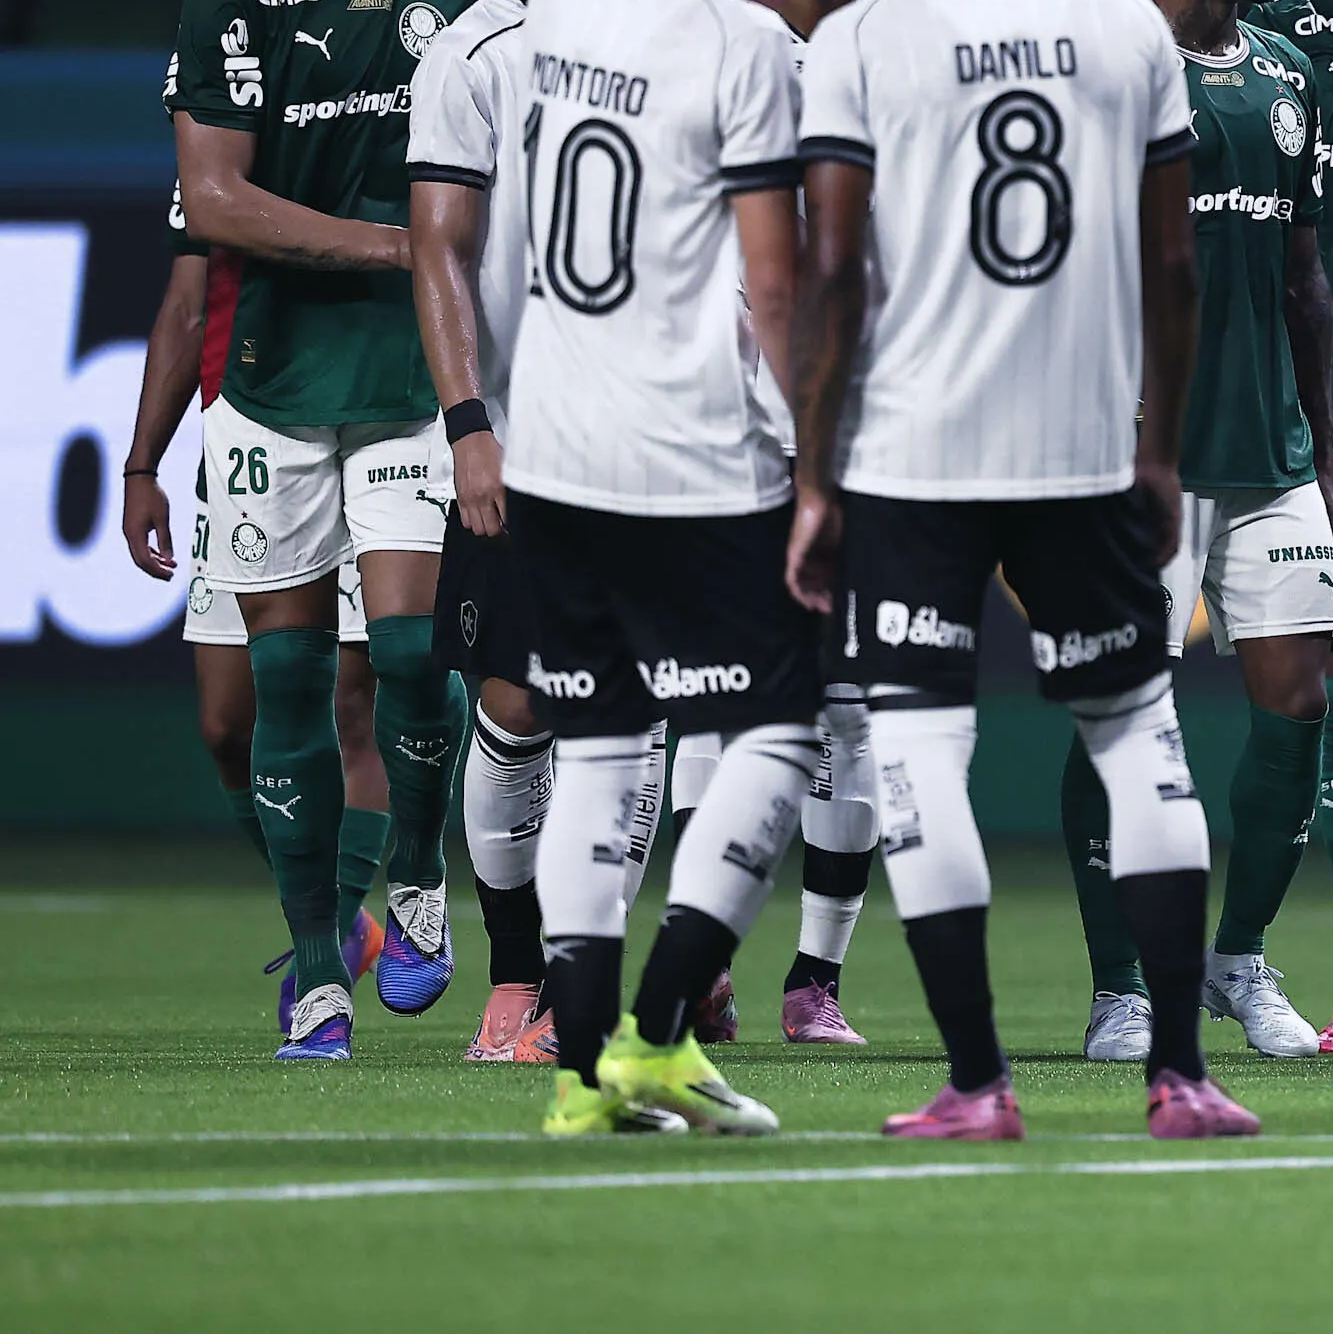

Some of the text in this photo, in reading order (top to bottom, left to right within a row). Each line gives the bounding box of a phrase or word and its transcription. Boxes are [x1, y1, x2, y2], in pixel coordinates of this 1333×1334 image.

[532, 52, 648, 116] MONTORO
[954, 39, 1077, 84] DANILO
[284, 85, 413, 128] sportingb
[523, 102, 642, 315] 10
[969, 91, 1073, 286] 8
[228, 447, 269, 494] 26
[367, 465, 428, 484] UNIASS
